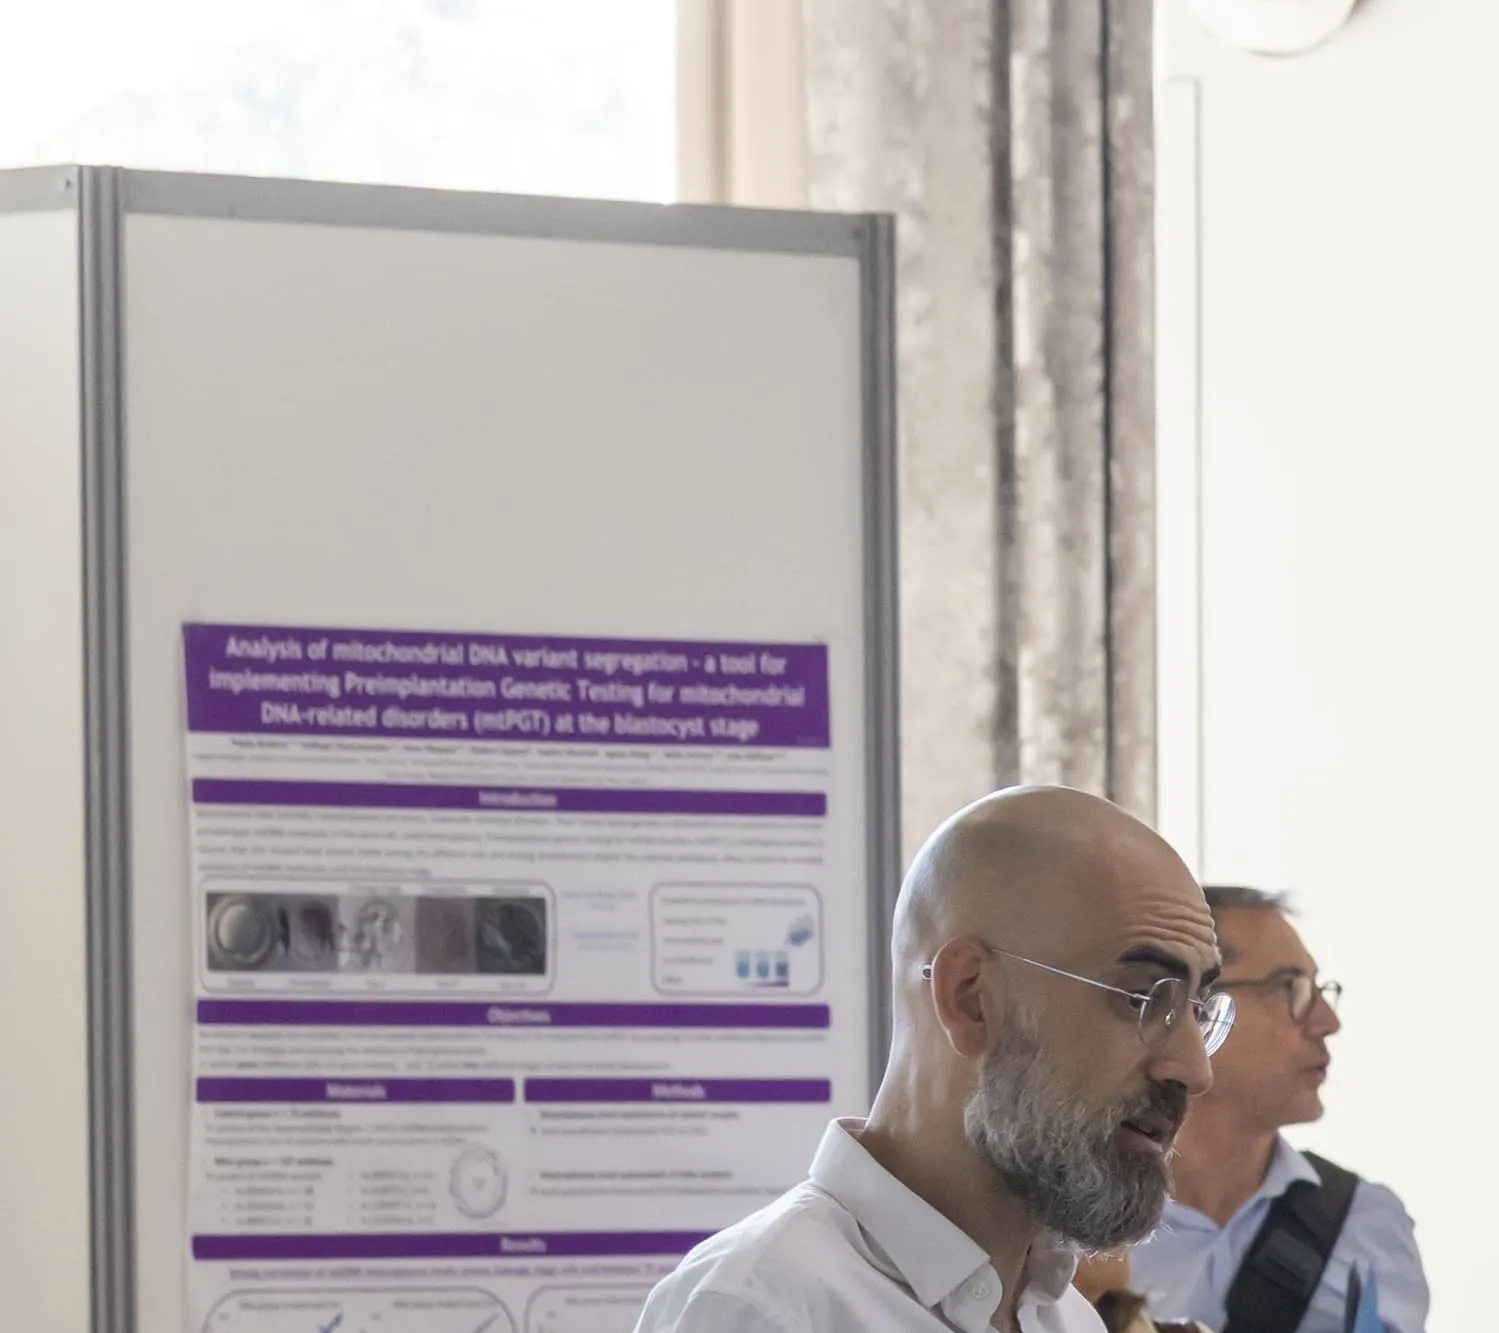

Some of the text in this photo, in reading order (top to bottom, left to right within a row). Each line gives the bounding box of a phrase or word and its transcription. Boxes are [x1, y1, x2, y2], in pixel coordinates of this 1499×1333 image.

[226, 636, 303, 664] Analysis
[307, 638, 328, 660] of
[332, 640, 464, 665] mitochondrial
[469, 643, 509, 665] DNA
[512, 646, 578, 669] variant
[583, 649, 688, 677] segregation
[704, 654, 716, 674] a
[720, 653, 756, 674] tool
[760, 652, 787, 675] for
[208, 667, 806, 707] Implementing Preimplantation Genetic Testing for mitochondrial
[260, 702, 377, 728] DNA-related
[381, 705, 469, 730] disorders
[554, 713, 574, 733] at
[578, 712, 610, 734] the
[709, 717, 760, 742] stage
